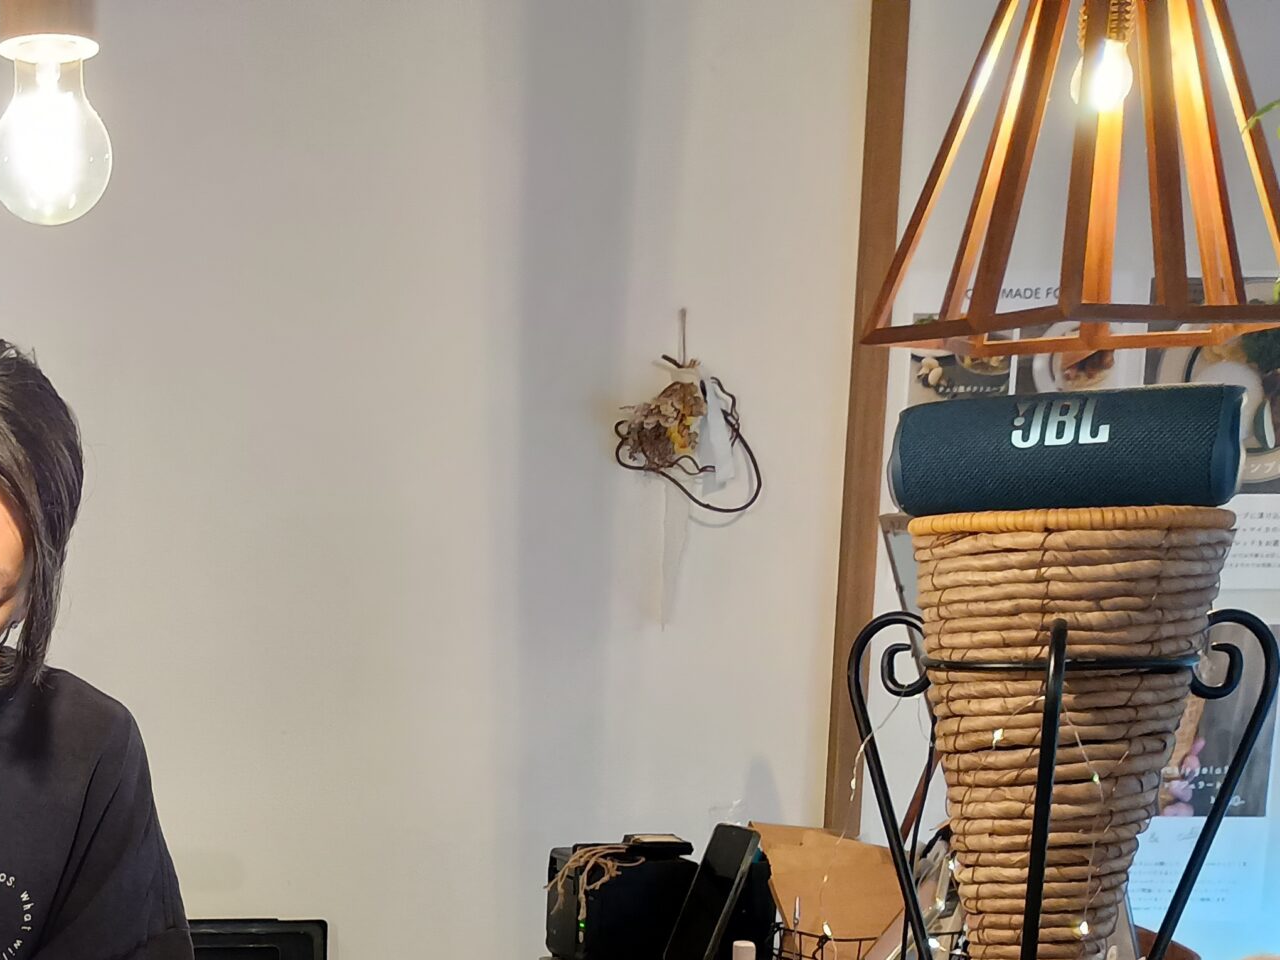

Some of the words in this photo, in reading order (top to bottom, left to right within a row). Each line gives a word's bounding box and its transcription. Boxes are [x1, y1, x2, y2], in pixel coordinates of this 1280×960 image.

[1001, 287, 1041, 300] MADE
[1011, 398, 1110, 448] JBL
[20, 891, 34, 931] what
